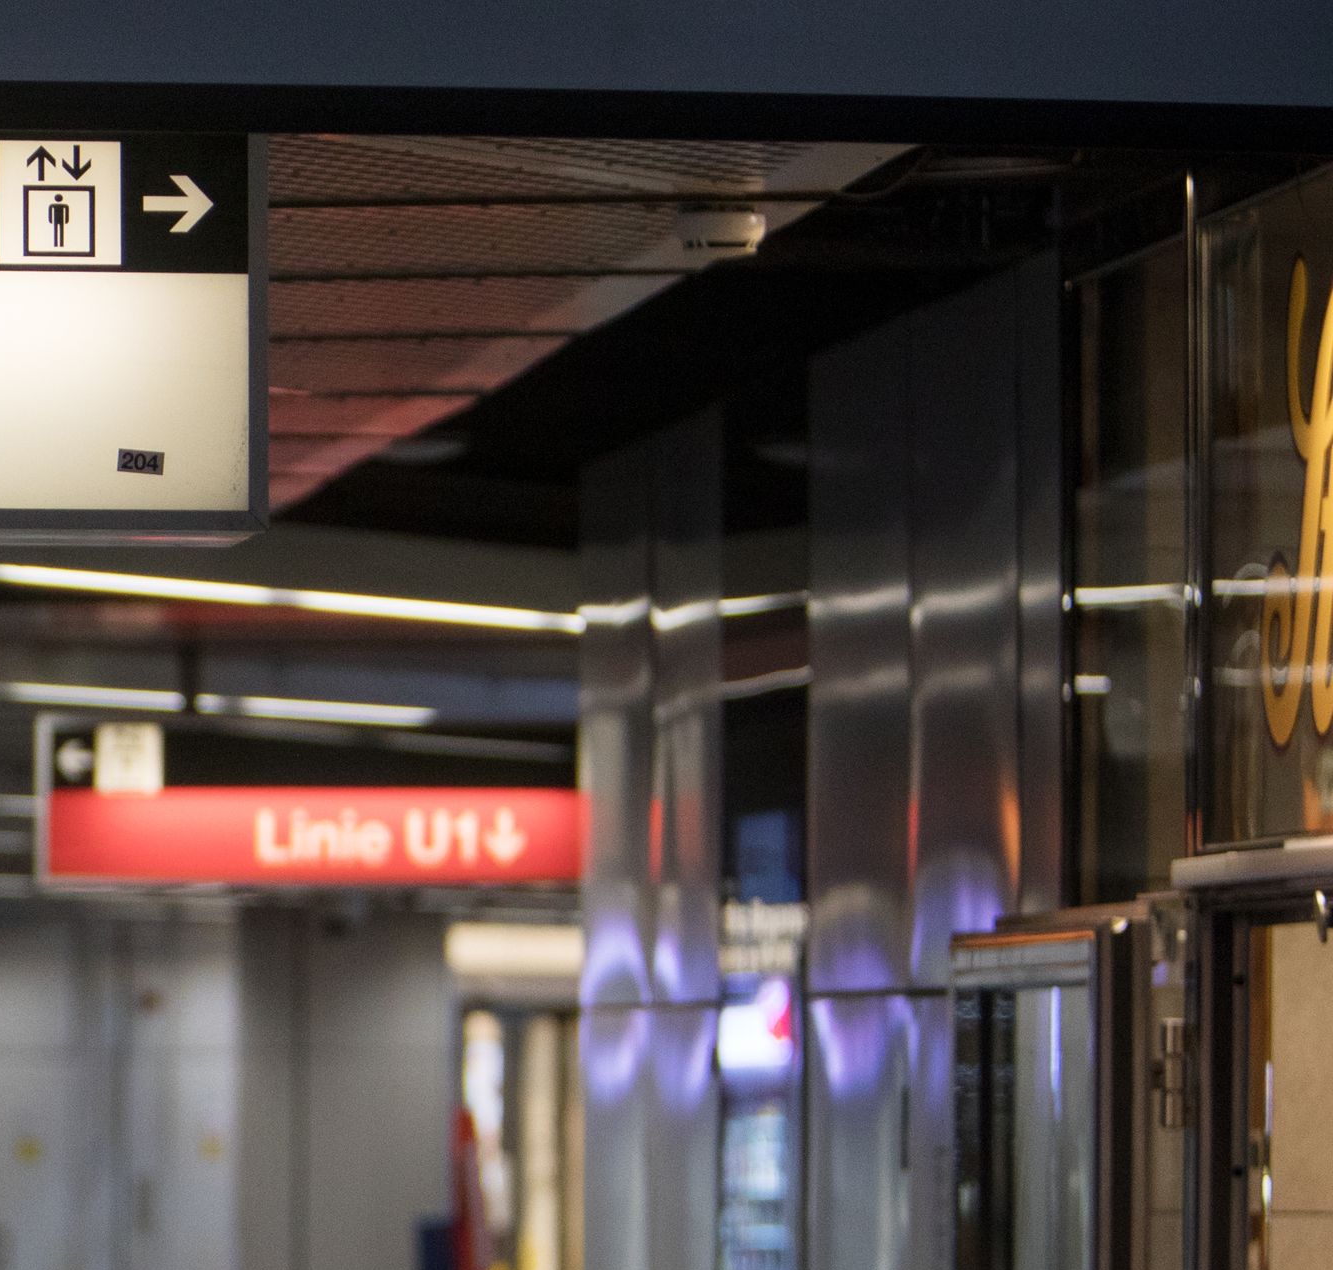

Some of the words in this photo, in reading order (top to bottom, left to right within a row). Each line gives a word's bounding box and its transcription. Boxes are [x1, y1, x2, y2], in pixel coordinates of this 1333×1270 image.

[120, 452, 161, 473] 204
[254, 806, 393, 867] Linie
[403, 807, 481, 868] U1
